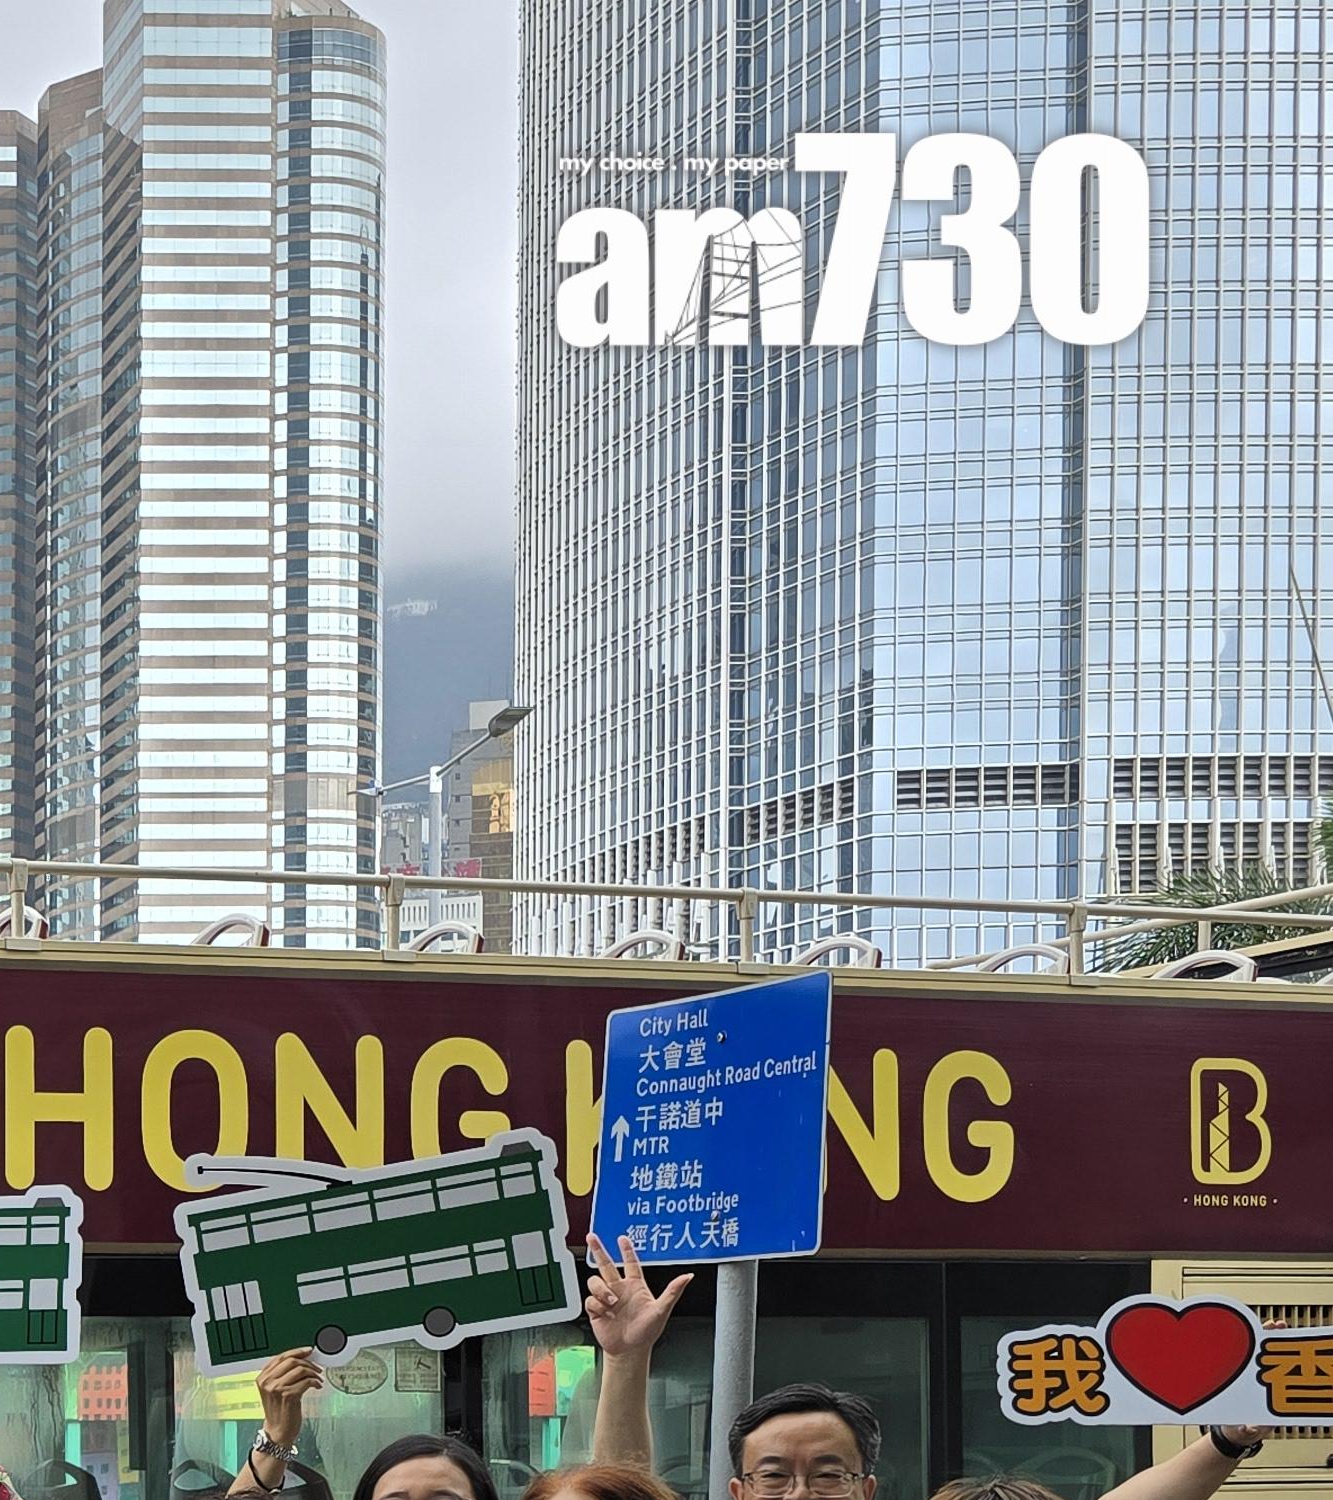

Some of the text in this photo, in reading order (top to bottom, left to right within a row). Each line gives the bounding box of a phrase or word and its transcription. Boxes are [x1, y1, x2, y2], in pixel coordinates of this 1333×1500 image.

[639, 1008, 709, 1037] City Hall
[638, 1037, 707, 1073] 大會堂
[636, 1051, 817, 1097] Connaught Road Central
[4, 1024, 511, 1194] HONG
[635, 1096, 723, 1132] 干諾道中
[632, 1136, 669, 1156] MTR
[629, 1159, 703, 1191] 地鐵站
[627, 1191, 739, 1215] via Footbridge
[1194, 1195, 1267, 1208] HONG KONG
[626, 1217, 740, 1252] 經行人天橋
[1007, 1332, 1110, 1417] 我
